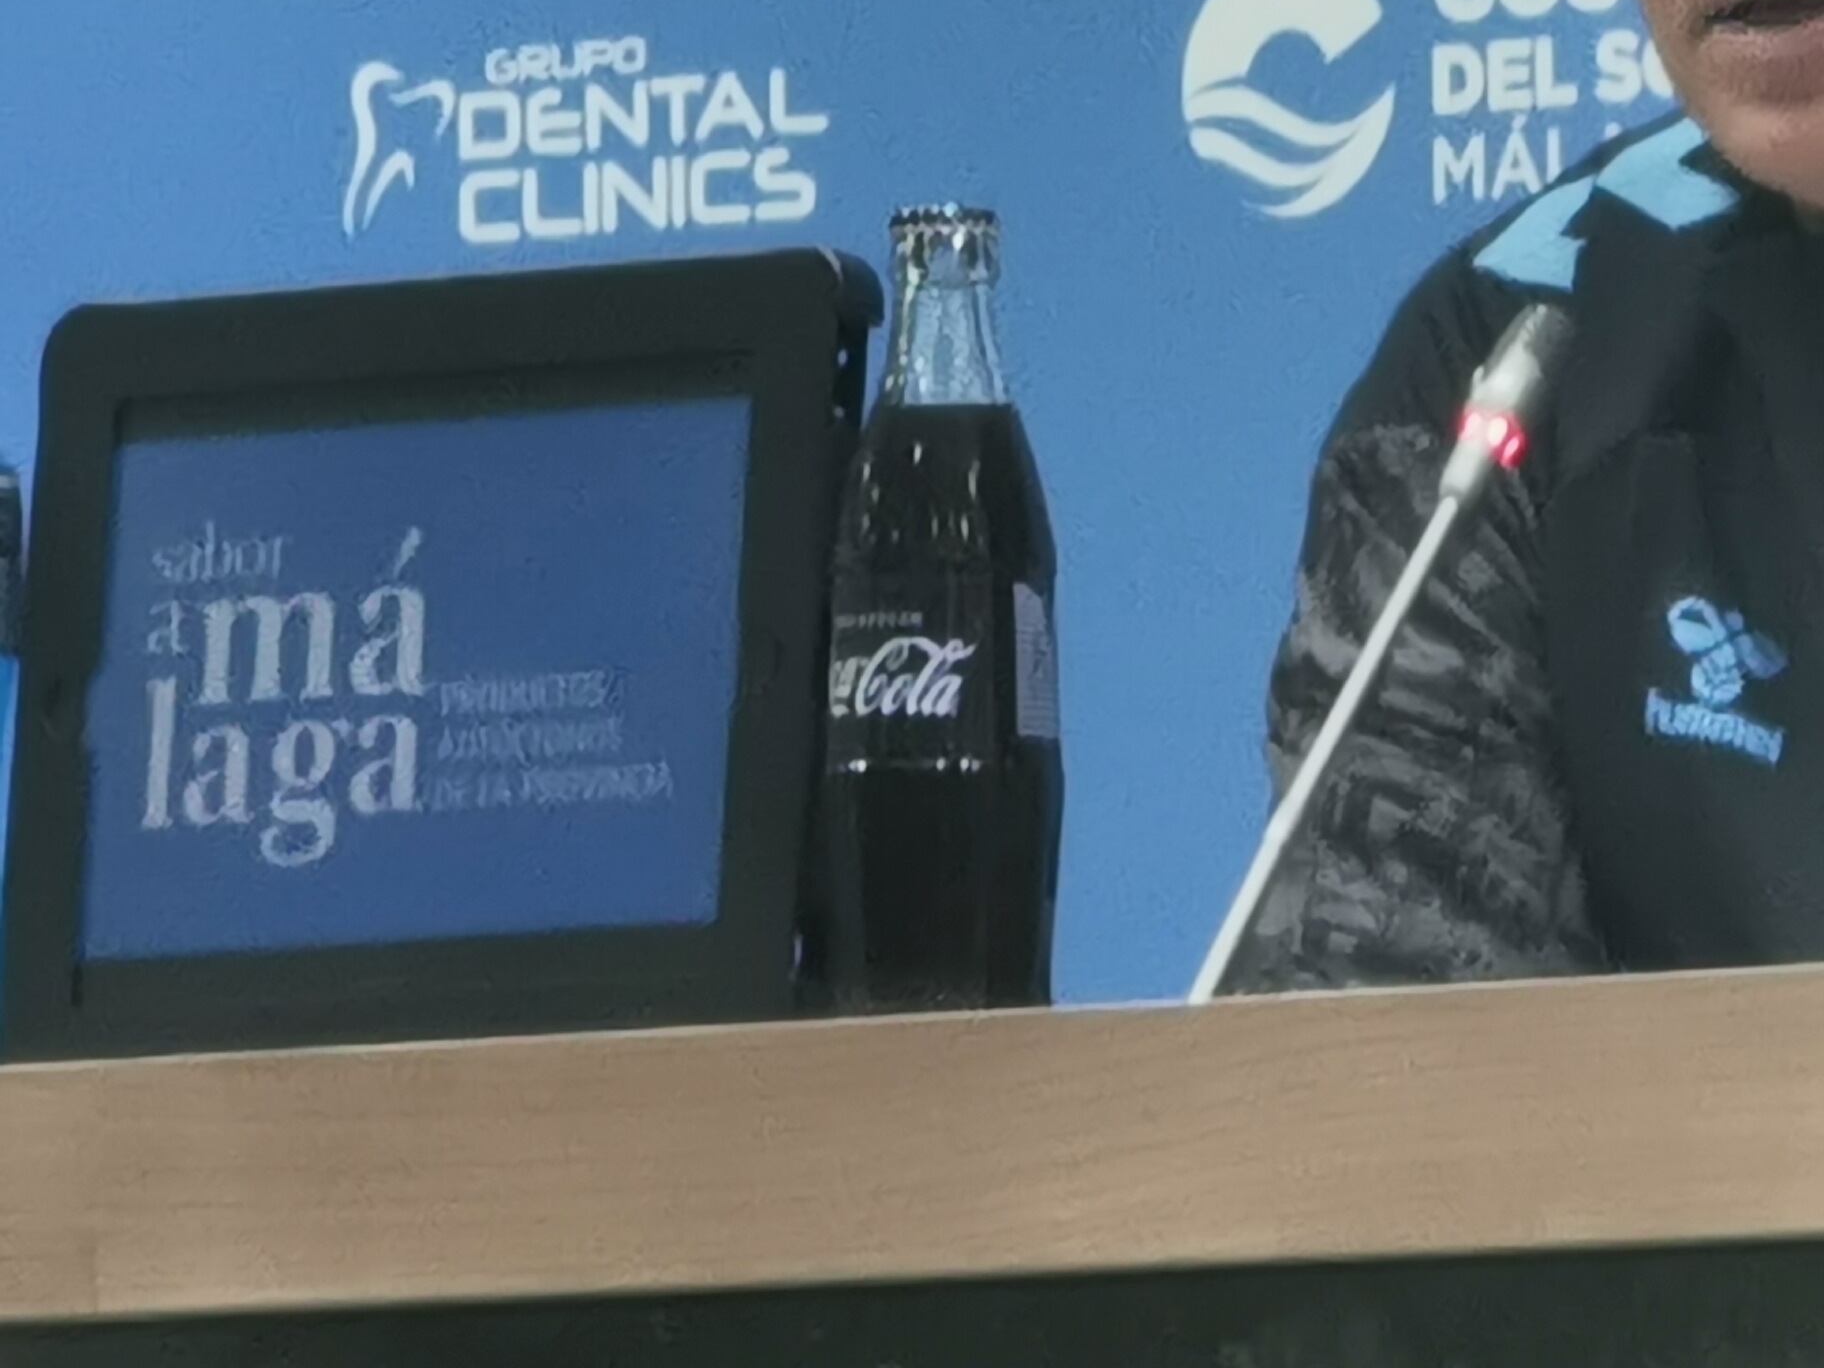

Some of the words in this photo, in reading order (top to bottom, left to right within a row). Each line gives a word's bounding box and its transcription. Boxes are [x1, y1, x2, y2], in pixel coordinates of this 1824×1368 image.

[484, 35, 647, 85] GRUPO
[1431, 34, 1579, 116] DEL
[458, 67, 829, 161] DENTAL
[458, 145, 816, 243] CLINICS
[150, 520, 292, 584] sabor
[140, 676, 425, 868] laga
